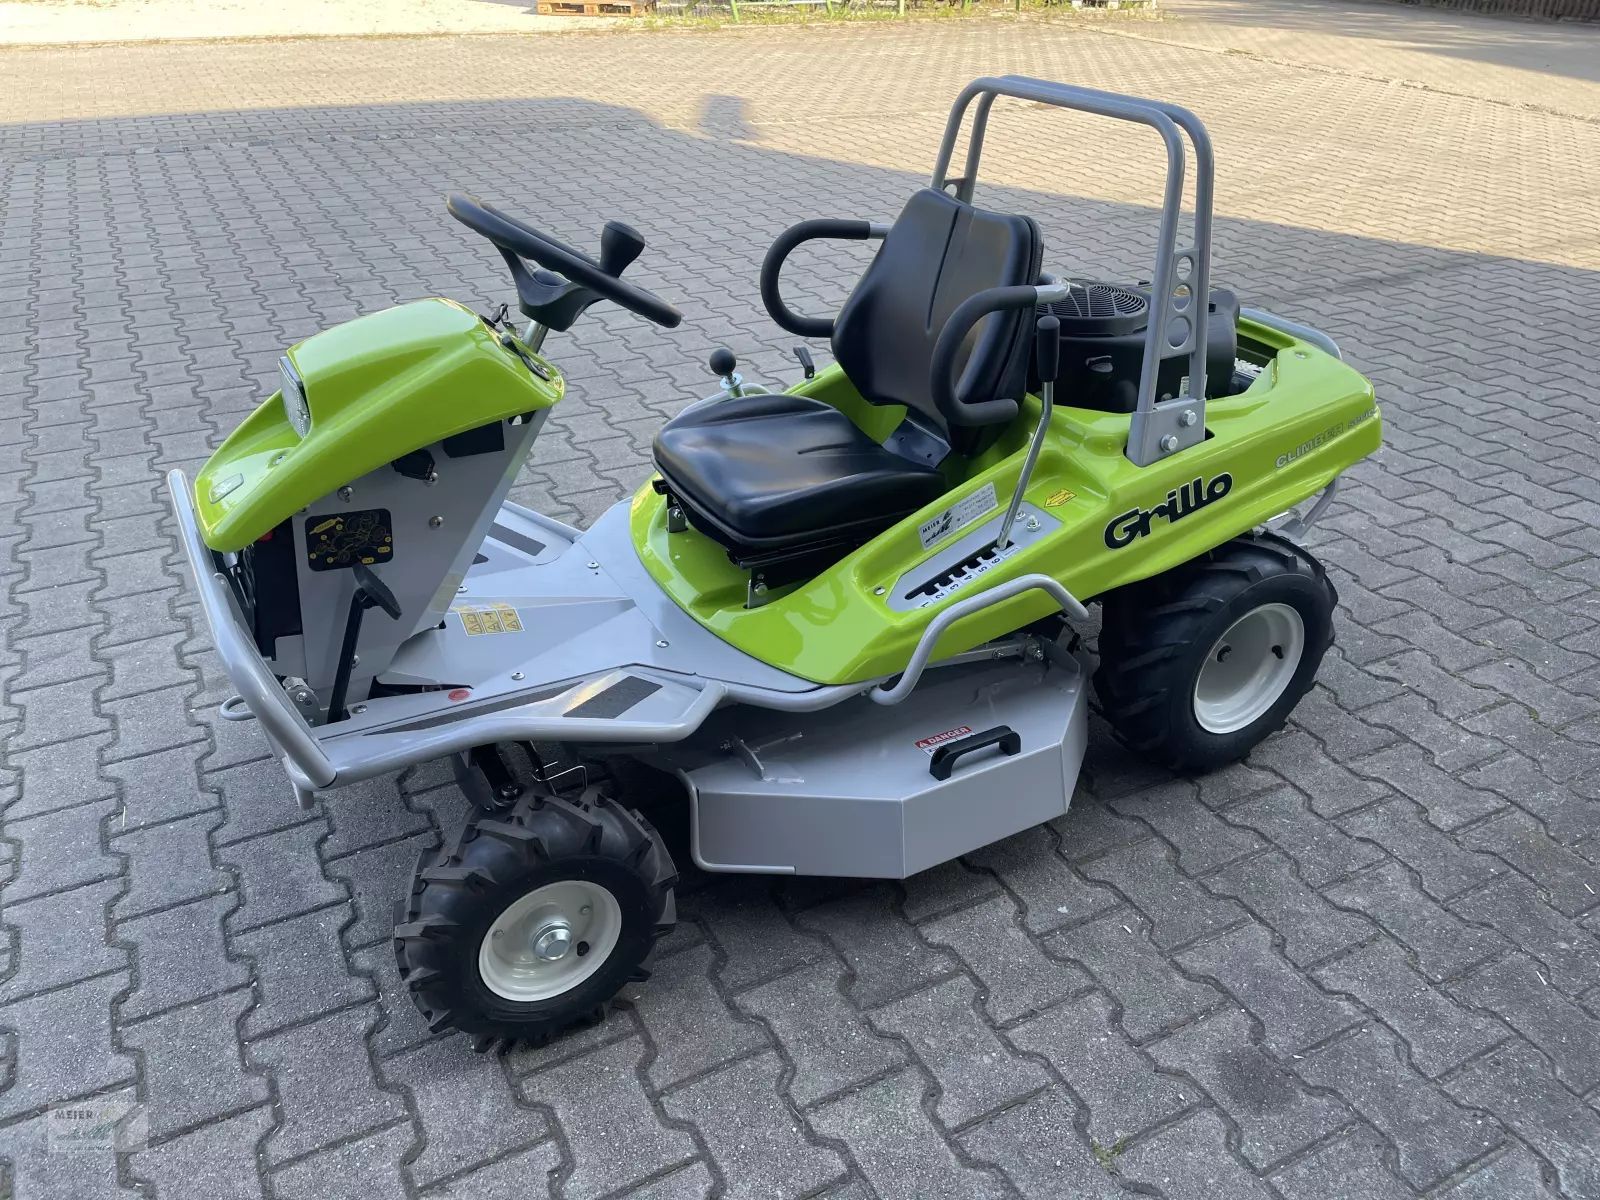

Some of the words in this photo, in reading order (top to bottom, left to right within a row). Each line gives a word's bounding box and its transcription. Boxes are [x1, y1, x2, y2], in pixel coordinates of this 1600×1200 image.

[1275, 422, 1345, 469] CLIMBER
[922, 520, 940, 533] MEIER
[1104, 472, 1233, 549] Grillo
[927, 726, 970, 744] DANGER
